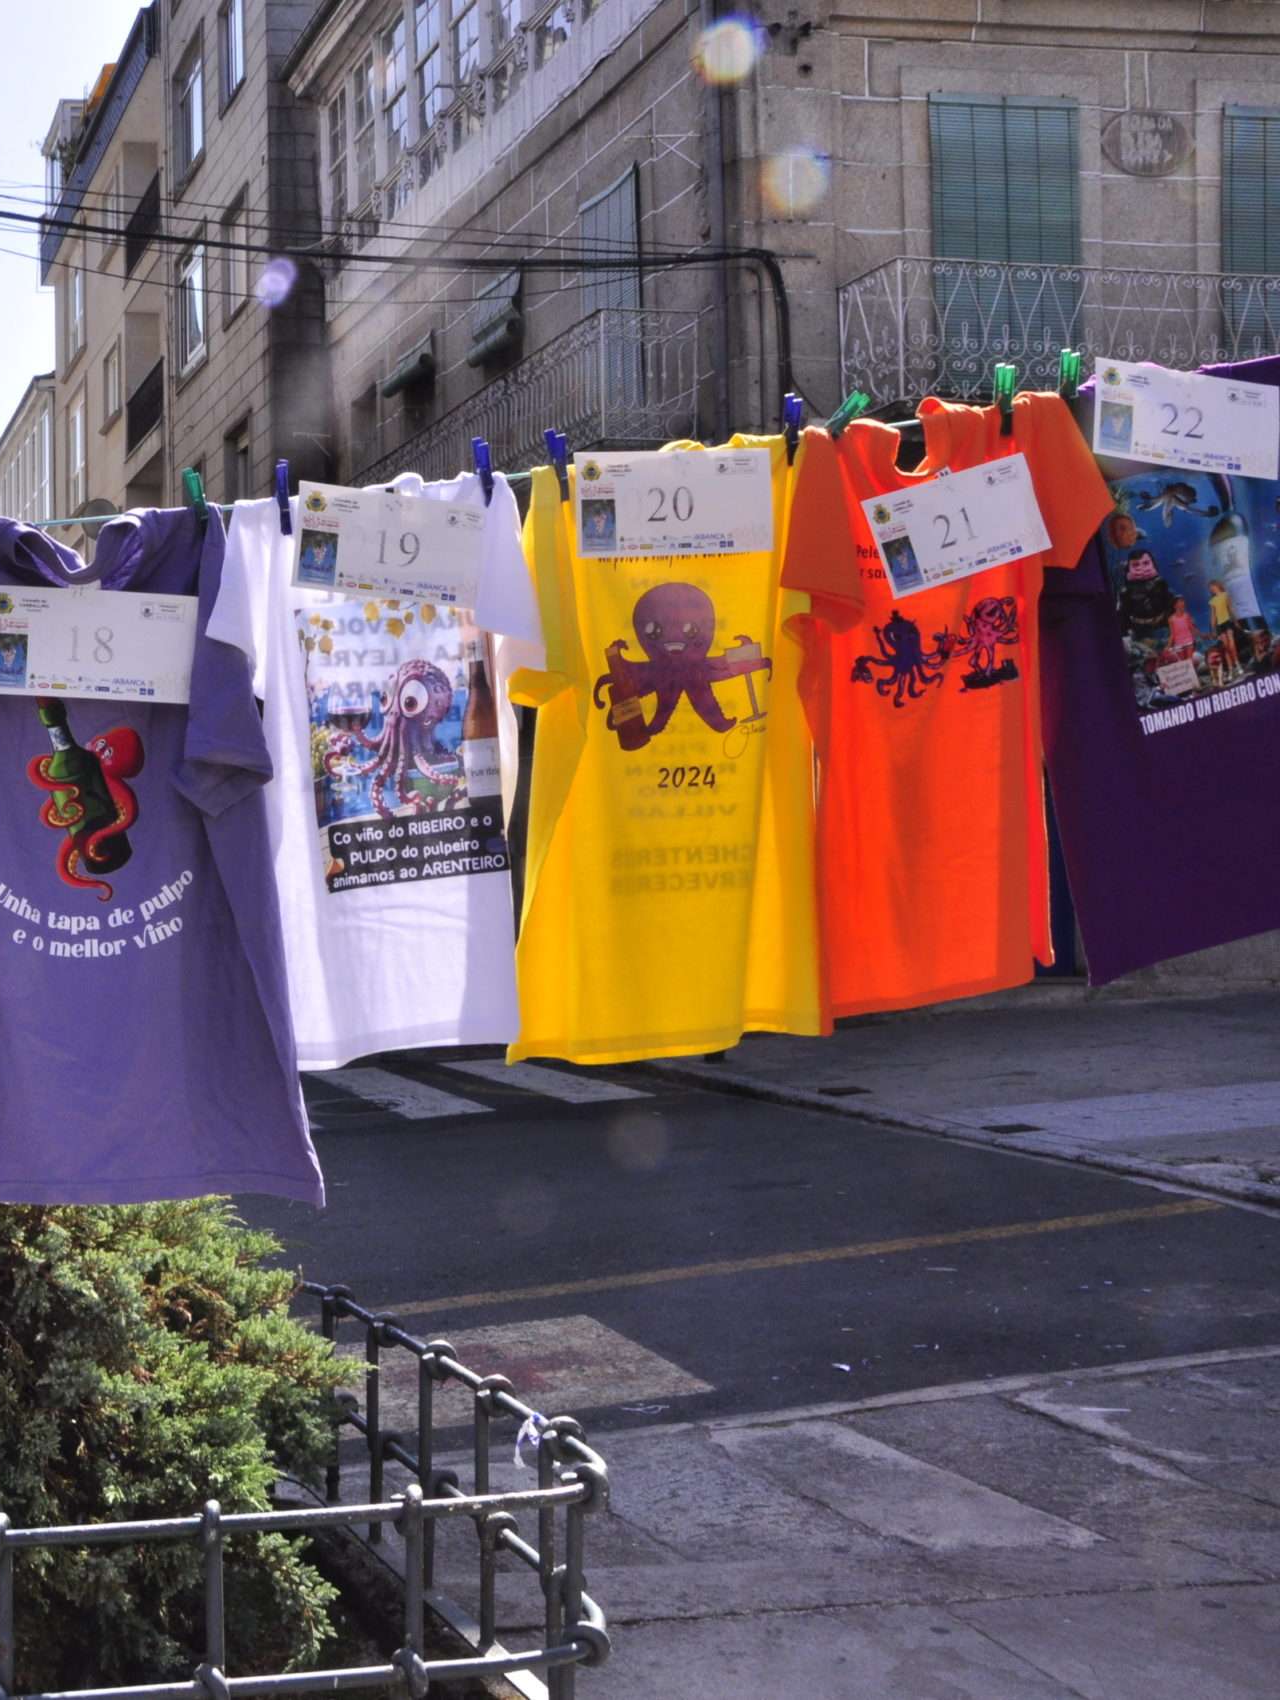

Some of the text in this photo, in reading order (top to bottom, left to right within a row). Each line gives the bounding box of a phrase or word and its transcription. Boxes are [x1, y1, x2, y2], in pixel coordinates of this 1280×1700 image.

[1160, 403, 1205, 439] 22
[647, 486, 695, 522] 20
[932, 507, 978, 549] 21
[375, 529, 421, 567] 19
[67, 626, 115, 664] 18
[1140, 702, 1195, 735] TOMANDO
[1195, 697, 1213, 719] UN
[1211, 681, 1256, 713] RIBEIRO
[657, 766, 717, 789] 2024
[333, 815, 492, 846] Co viño do RIBEIRO e o
[350, 838, 480, 866] PULPO do pulpeiro
[333, 854, 506, 889] animamos ao ARENTEIRO
[47, 911, 100, 935] tapa
[107, 908, 134, 928] de
[139, 869, 193, 921] pulpo
[12, 916, 183, 958] e o mellor viño
